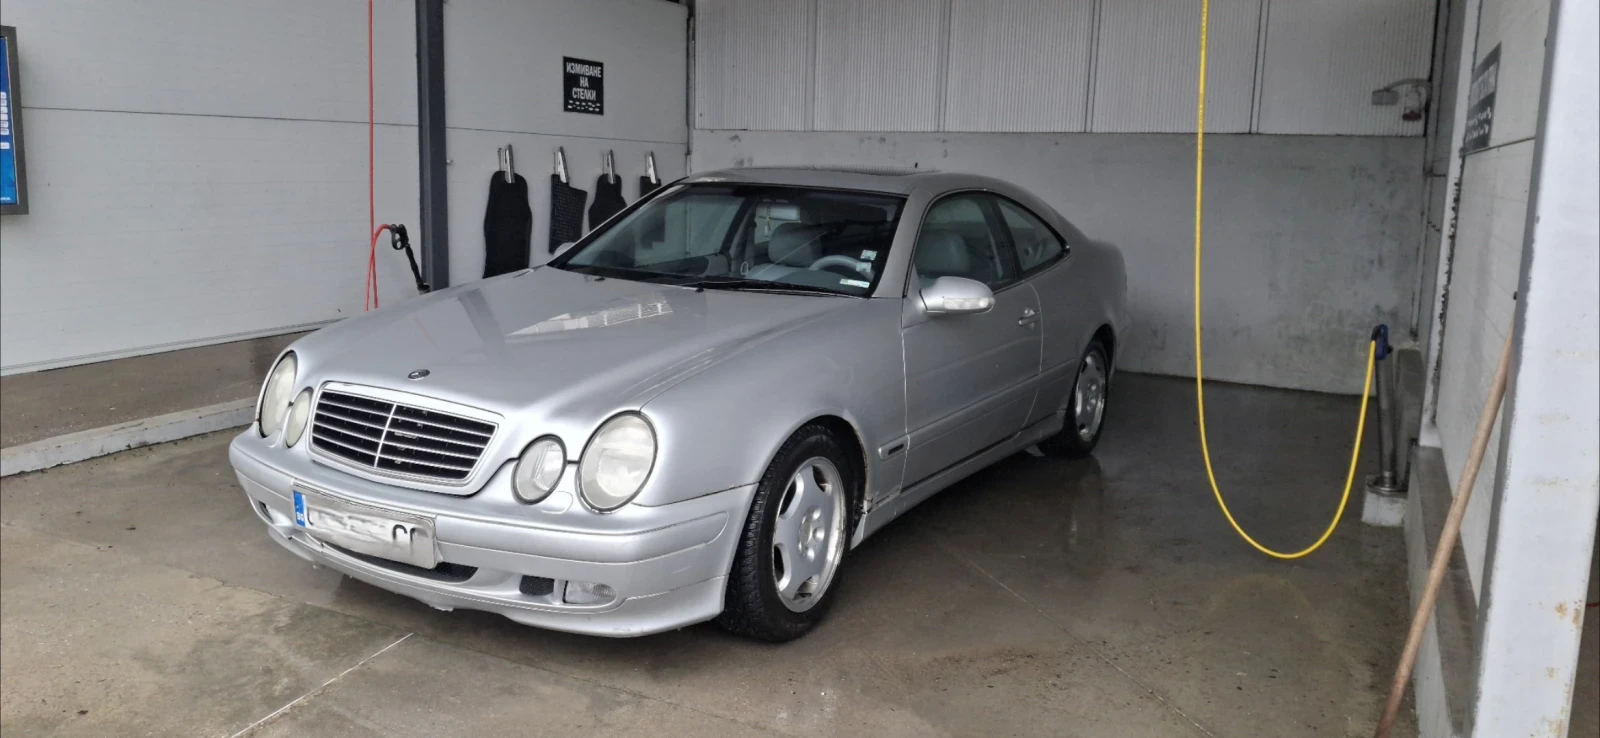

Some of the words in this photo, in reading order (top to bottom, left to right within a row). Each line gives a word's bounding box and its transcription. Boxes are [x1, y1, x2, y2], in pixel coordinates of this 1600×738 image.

[566, 62, 601, 77] ИЗМИВАНЕ
[580, 76, 589, 87] НА
[572, 88, 596, 100] СТЕЛКИ
